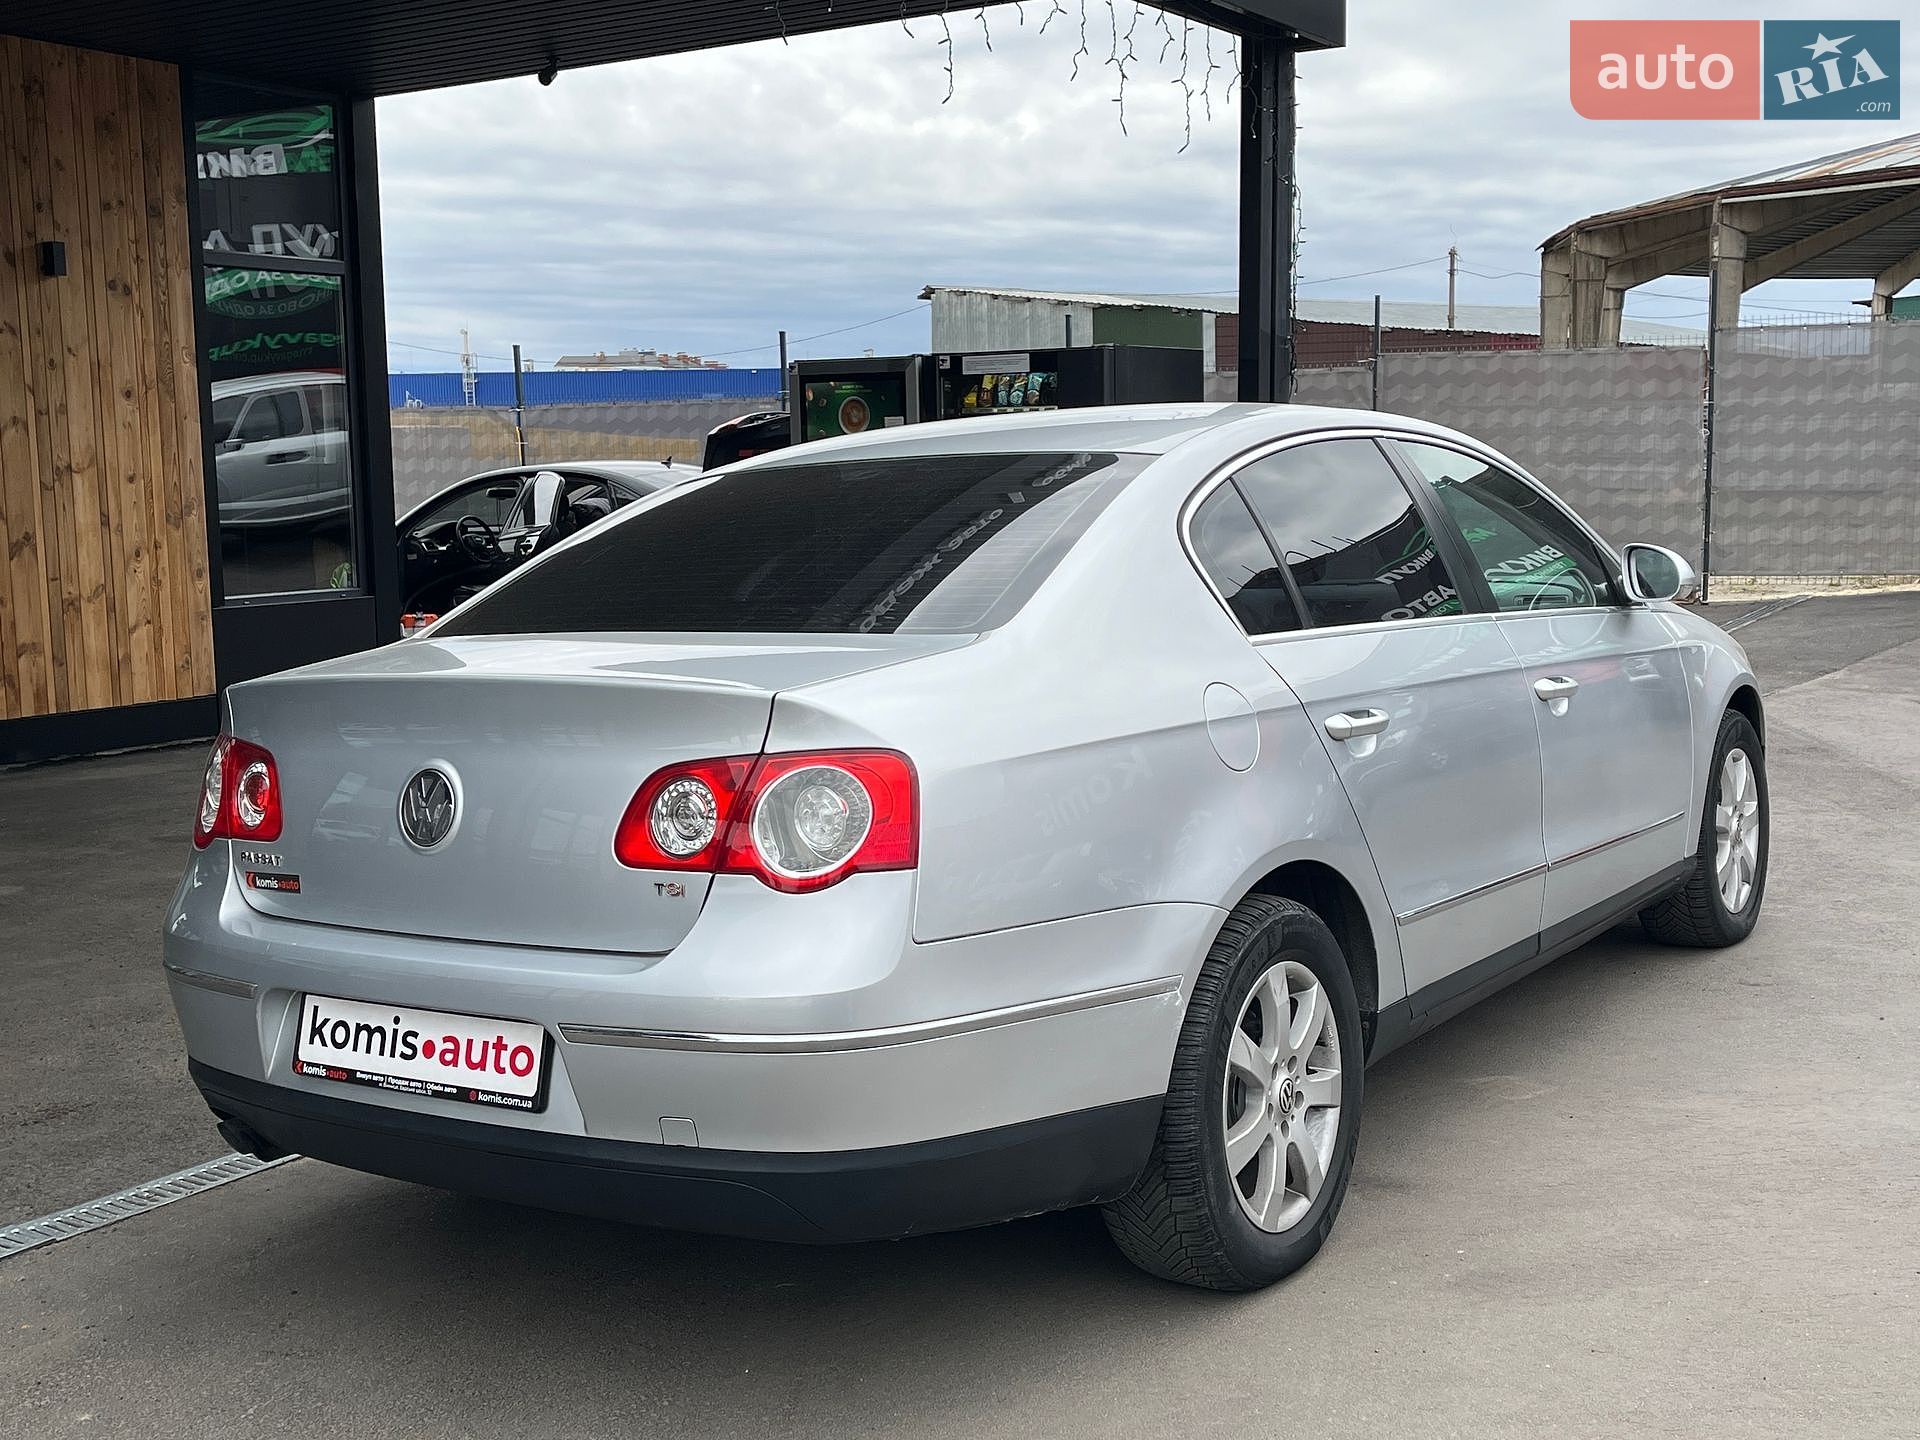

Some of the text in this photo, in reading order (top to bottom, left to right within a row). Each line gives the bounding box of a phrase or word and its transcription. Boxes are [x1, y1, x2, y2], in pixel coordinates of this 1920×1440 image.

[240, 851, 283, 867] PASSAT
[654, 881, 685, 898] TSI
[478, 1091, 533, 1109] komis.com.ua
